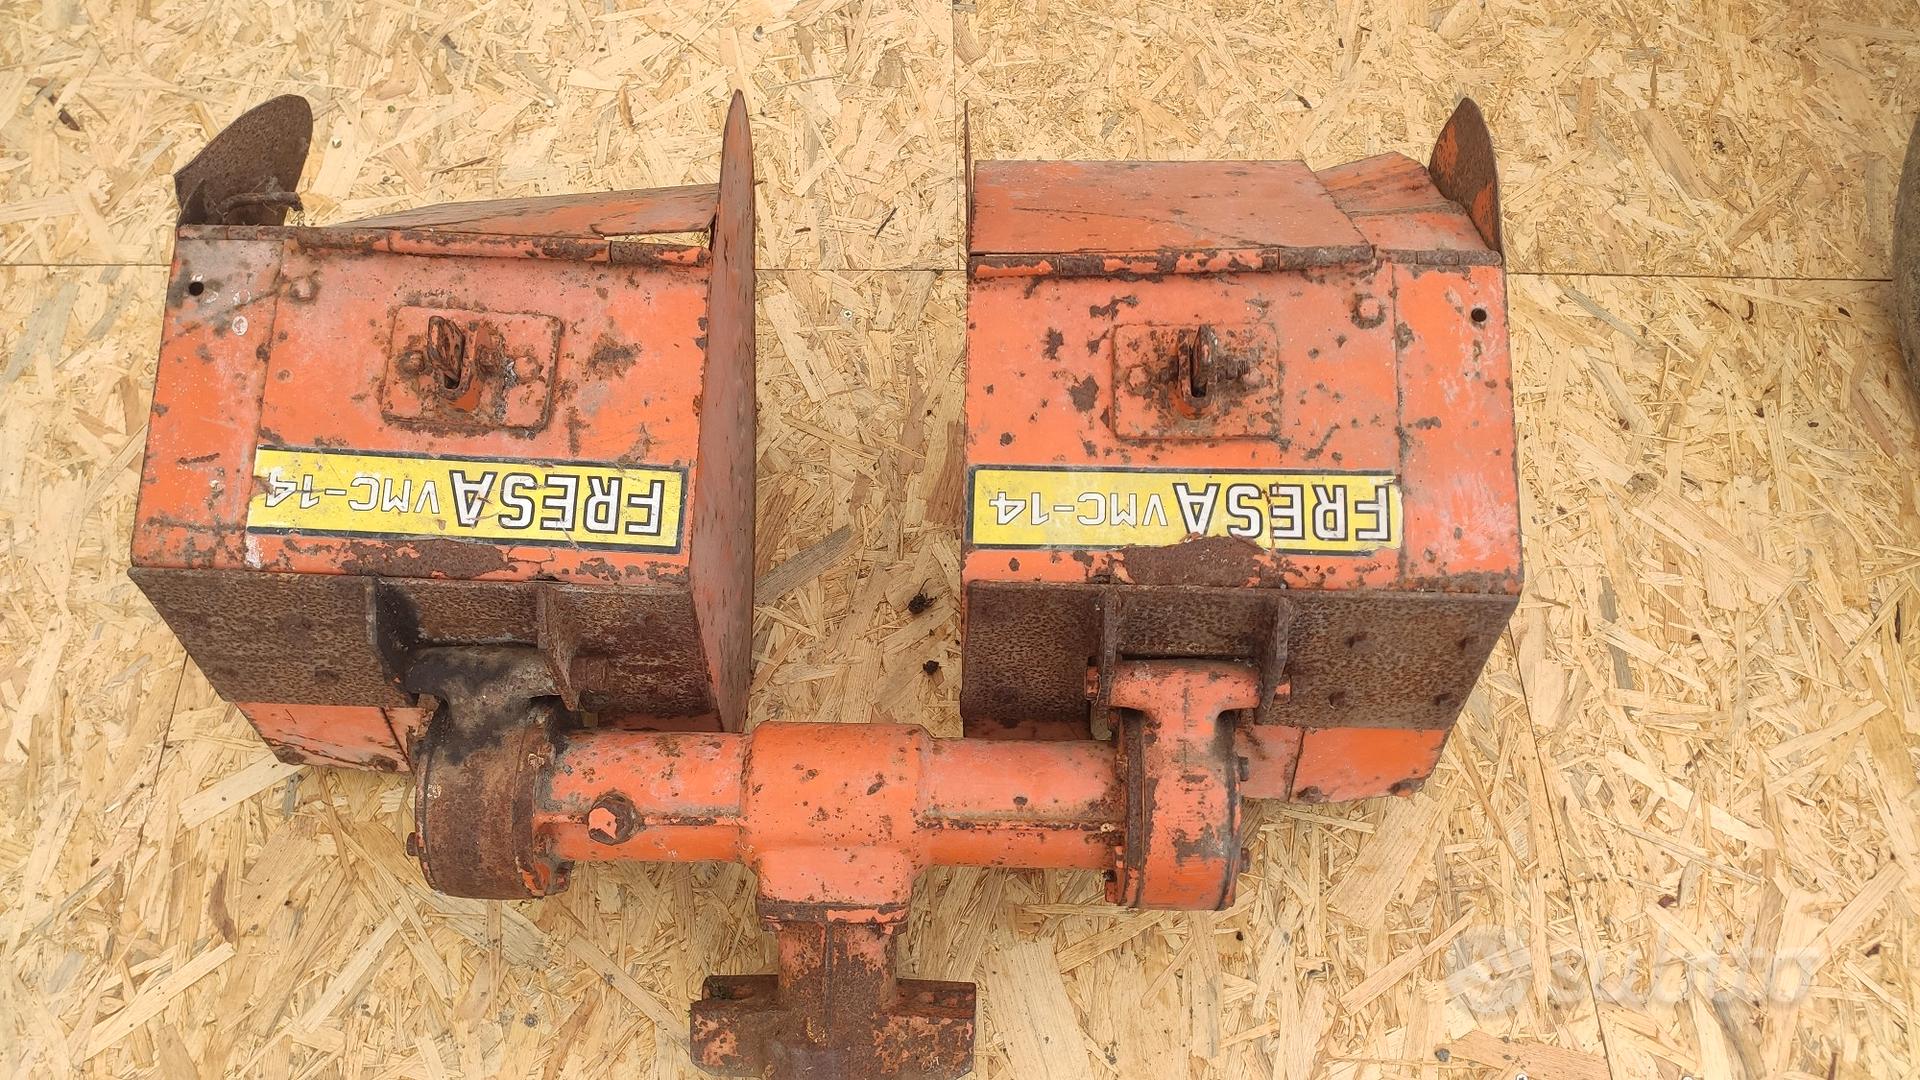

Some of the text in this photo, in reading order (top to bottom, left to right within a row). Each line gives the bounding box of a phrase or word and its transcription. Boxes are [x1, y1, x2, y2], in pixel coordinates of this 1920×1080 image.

[264, 469, 663, 537] FRESA VMC-14
[989, 483, 1391, 541] FRESA VMC-14
